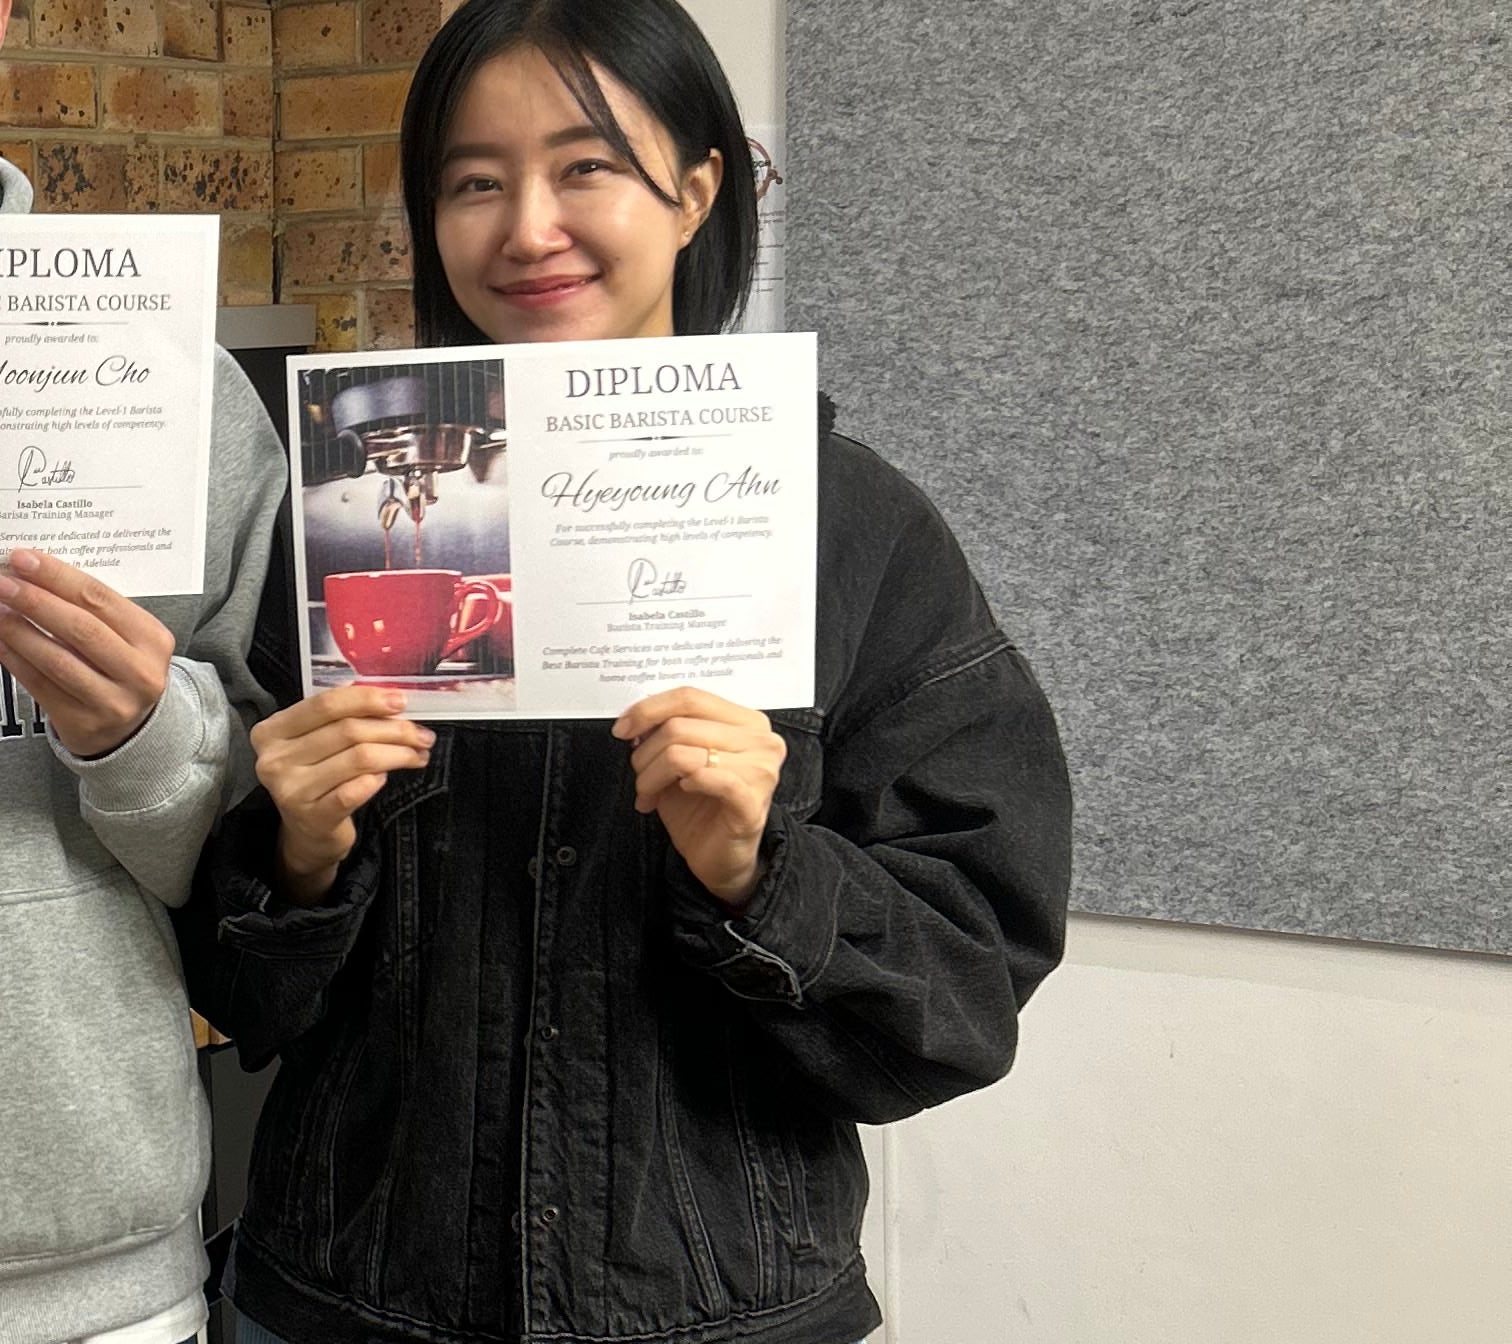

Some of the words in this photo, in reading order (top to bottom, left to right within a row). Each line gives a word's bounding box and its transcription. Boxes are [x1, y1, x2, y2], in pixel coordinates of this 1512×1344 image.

[7, 294, 90, 312] BARISTA
[96, 294, 172, 311] COURSE
[5, 334, 42, 345] proudly
[44, 334, 84, 343] awarded
[95, 355, 151, 387] Cho
[565, 362, 743, 398] DIPLOMA
[25, 407, 77, 418] completing
[79, 406, 94, 415] the
[130, 406, 162, 415] Barista
[52, 421, 72, 431] high
[74, 421, 99, 429] levels
[102, 420, 112, 430] of
[546, 414, 605, 433] BASIC
[610, 409, 694, 429] BARISTA
[699, 406, 774, 424] COURSE
[540, 469, 697, 513] Hyeyoung
[704, 465, 781, 503] Ahn
[17, 500, 53, 509] Isabela
[55, 500, 93, 508] Castillo
[32, 510, 72, 521] Training
[74, 509, 114, 520] Manager
[0, 533, 38, 541] Services
[58, 531, 100, 541] dedicated
[112, 528, 155, 539] delivering
[158, 528, 171, 537] the
[47, 546, 68, 555] both
[70, 545, 94, 555] coffee
[96, 543, 154, 554] professionals
[156, 542, 173, 550] and
[72, 559, 81, 568] in
[83, 558, 121, 567] Adelaide
